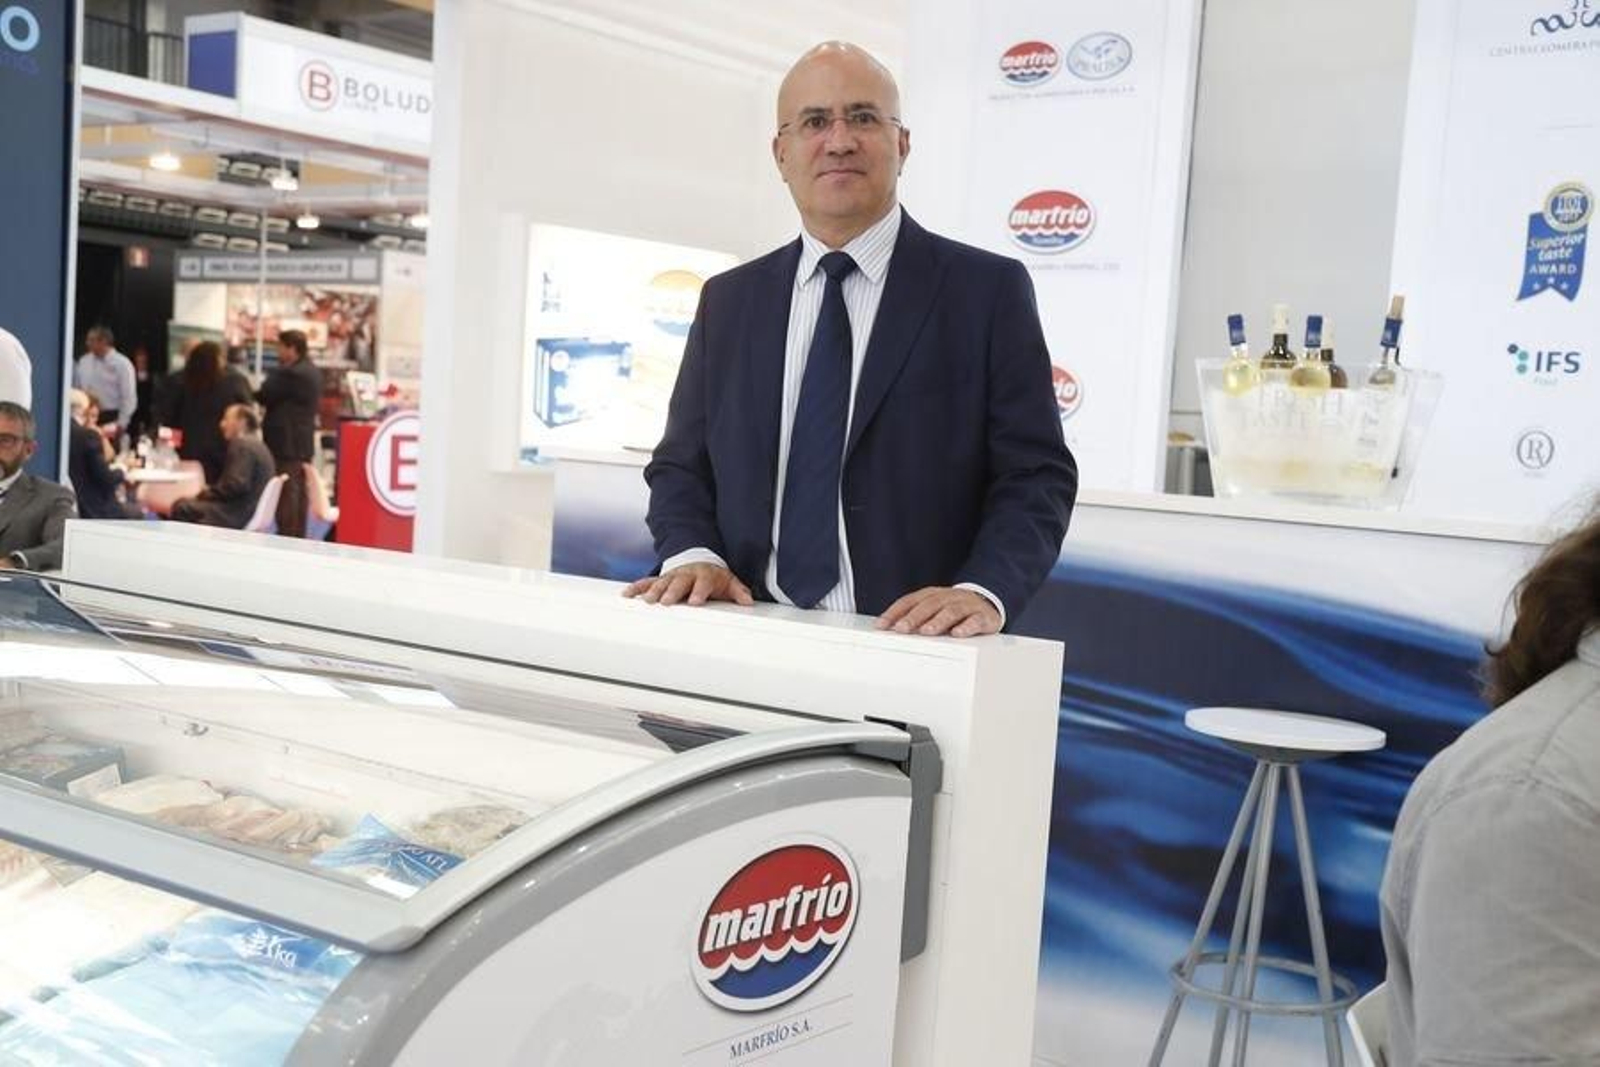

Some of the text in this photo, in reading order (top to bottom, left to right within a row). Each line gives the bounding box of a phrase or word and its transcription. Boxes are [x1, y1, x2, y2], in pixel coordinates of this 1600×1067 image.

[1529, 263, 1577, 275] AWARD
[1535, 350, 1581, 374] IFS
[702, 873, 849, 953] marfrío
